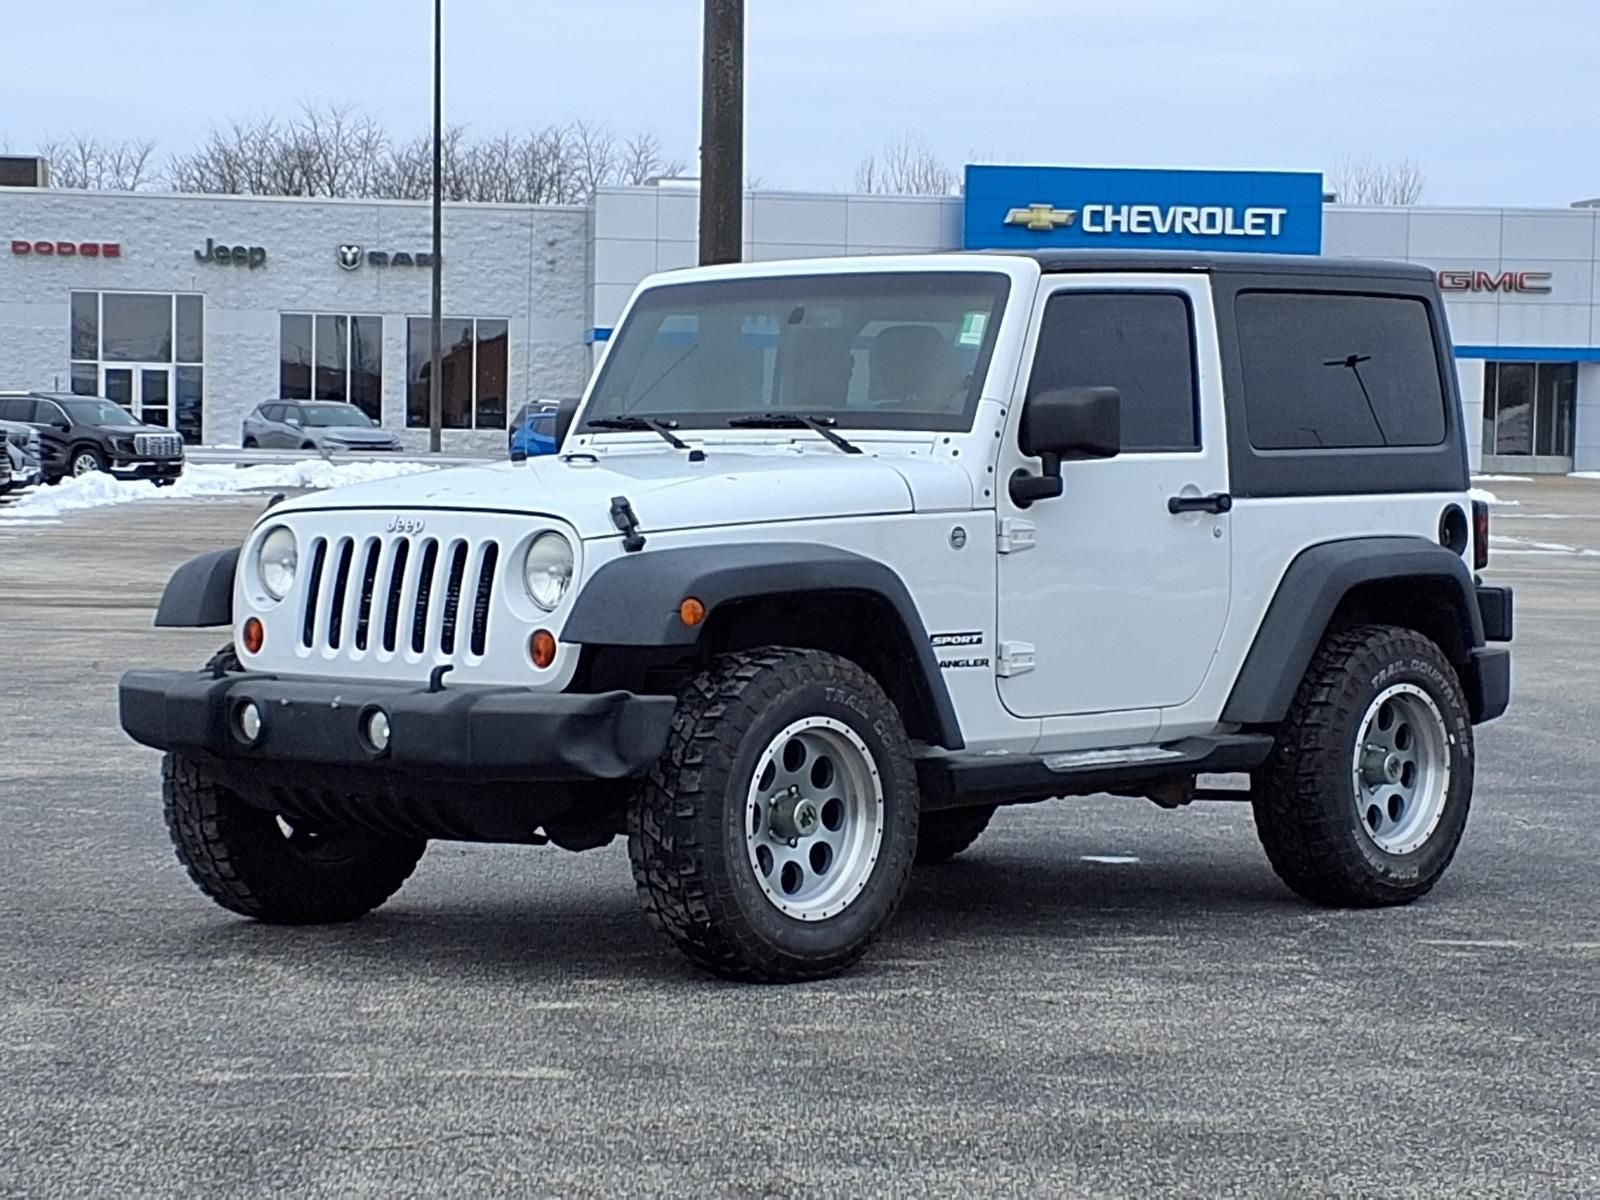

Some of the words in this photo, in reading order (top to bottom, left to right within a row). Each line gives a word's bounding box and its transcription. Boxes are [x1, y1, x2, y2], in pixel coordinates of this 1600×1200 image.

[1082, 204, 1288, 236] CHEVROLET
[11, 240, 121, 258] DODGE
[193, 237, 267, 270] Jeep
[367, 251, 434, 268] RAM
[1437, 270, 1553, 293] GMC
[386, 515, 425, 537] Jeep
[930, 633, 983, 646] SPORT
[939, 658, 990, 668] ANGLER
[1371, 660, 1409, 689] TRAIL
